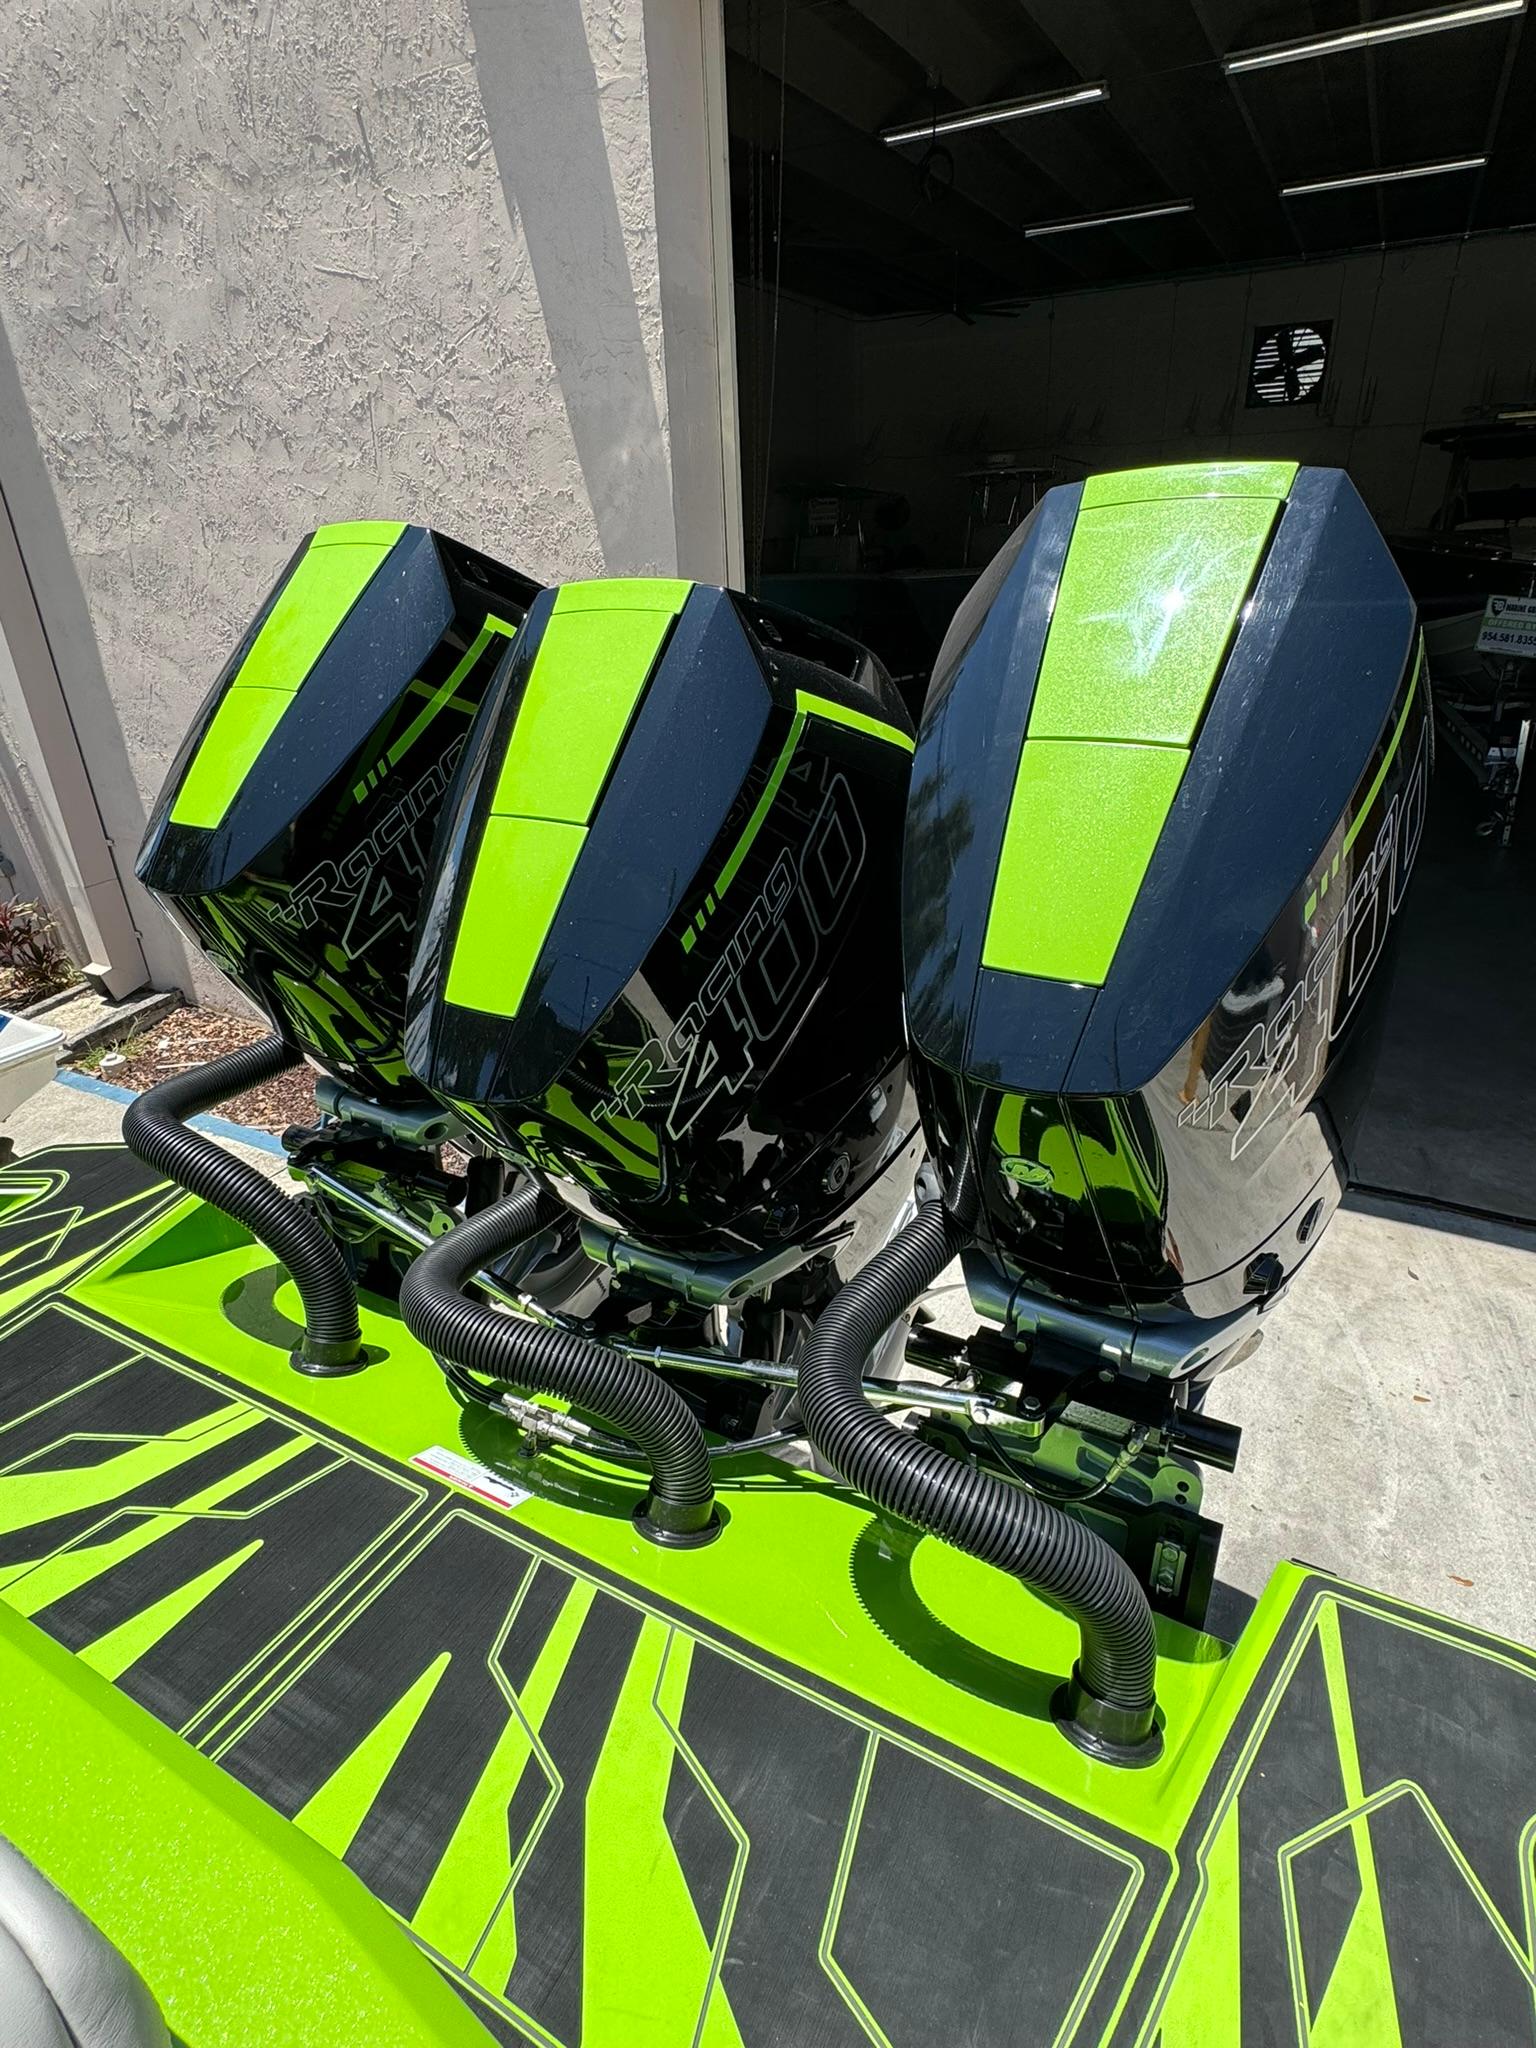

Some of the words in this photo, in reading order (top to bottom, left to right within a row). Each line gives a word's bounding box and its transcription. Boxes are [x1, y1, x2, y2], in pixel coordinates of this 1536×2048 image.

[1488, 618, 1524, 628] OFFERED
[1505, 603, 1527, 612] MARINE
[612, 847, 799, 1119] Racing
[667, 773, 866, 1140] 400
[1208, 795, 1398, 1129] Racing
[1231, 715, 1429, 1160] 400
